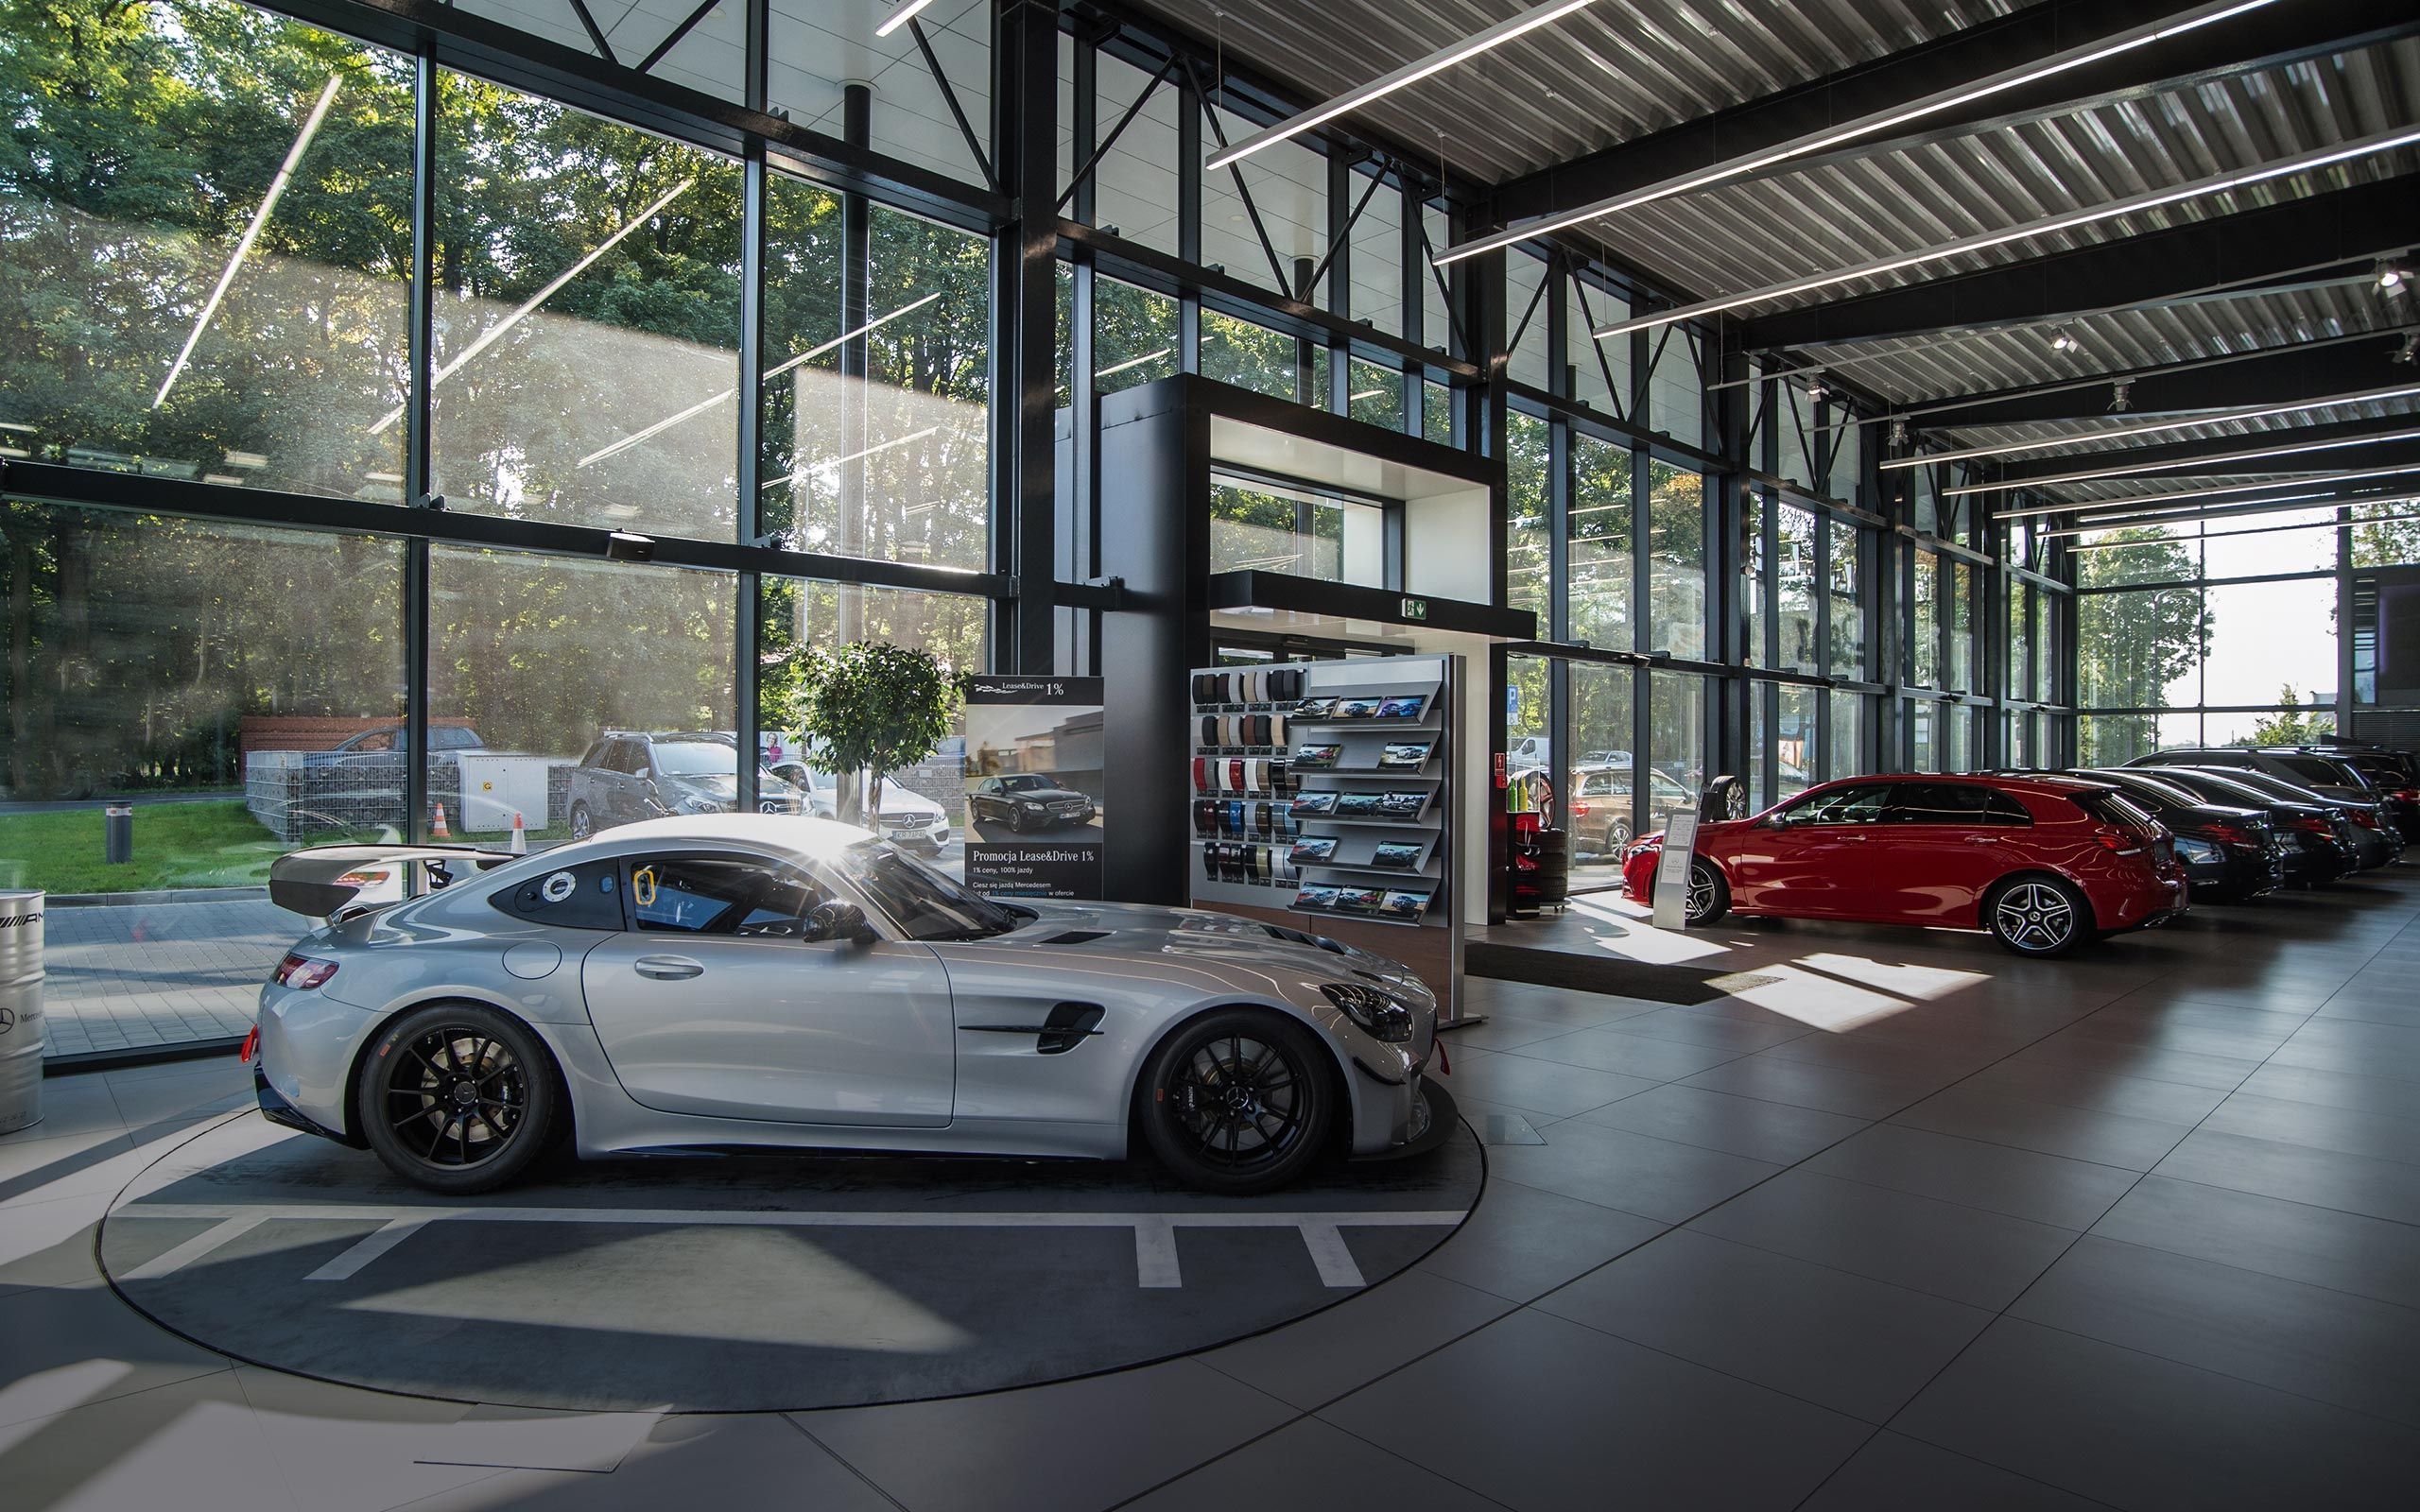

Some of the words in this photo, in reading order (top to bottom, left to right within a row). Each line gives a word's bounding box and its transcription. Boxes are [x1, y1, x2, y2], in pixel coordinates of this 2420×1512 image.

[1002, 681, 1045, 690] Lease&Drive
[1046, 683, 1064, 696] 1%
[1509, 687, 1516, 705] P
[973, 850, 1017, 864] Promocja
[1020, 850, 1079, 862] Lease&Drive
[1081, 850, 1095, 862] 1%
[1016, 867, 1033, 875] jazdy
